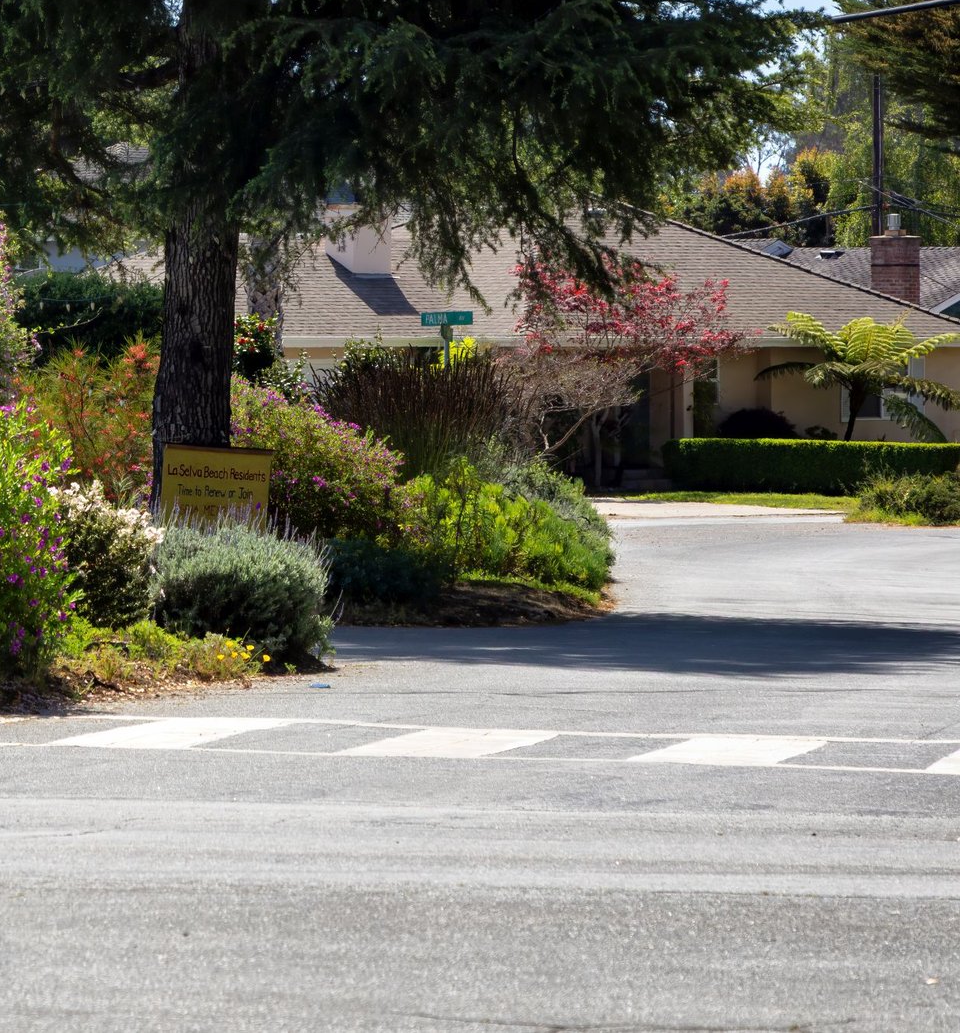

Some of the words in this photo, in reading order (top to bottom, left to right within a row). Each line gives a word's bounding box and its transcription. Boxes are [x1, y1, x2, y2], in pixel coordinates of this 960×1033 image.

[425, 313, 448, 324] PALMA
[167, 463, 178, 476] La
[178, 463, 202, 478] Selva
[203, 465, 228, 480] Beach
[230, 467, 266, 483] Residents
[177, 483, 193, 496] Time
[195, 485, 202, 497] to
[204, 484, 227, 498] Renew
[228, 489, 237, 498] or
[238, 486, 253, 500] Join
